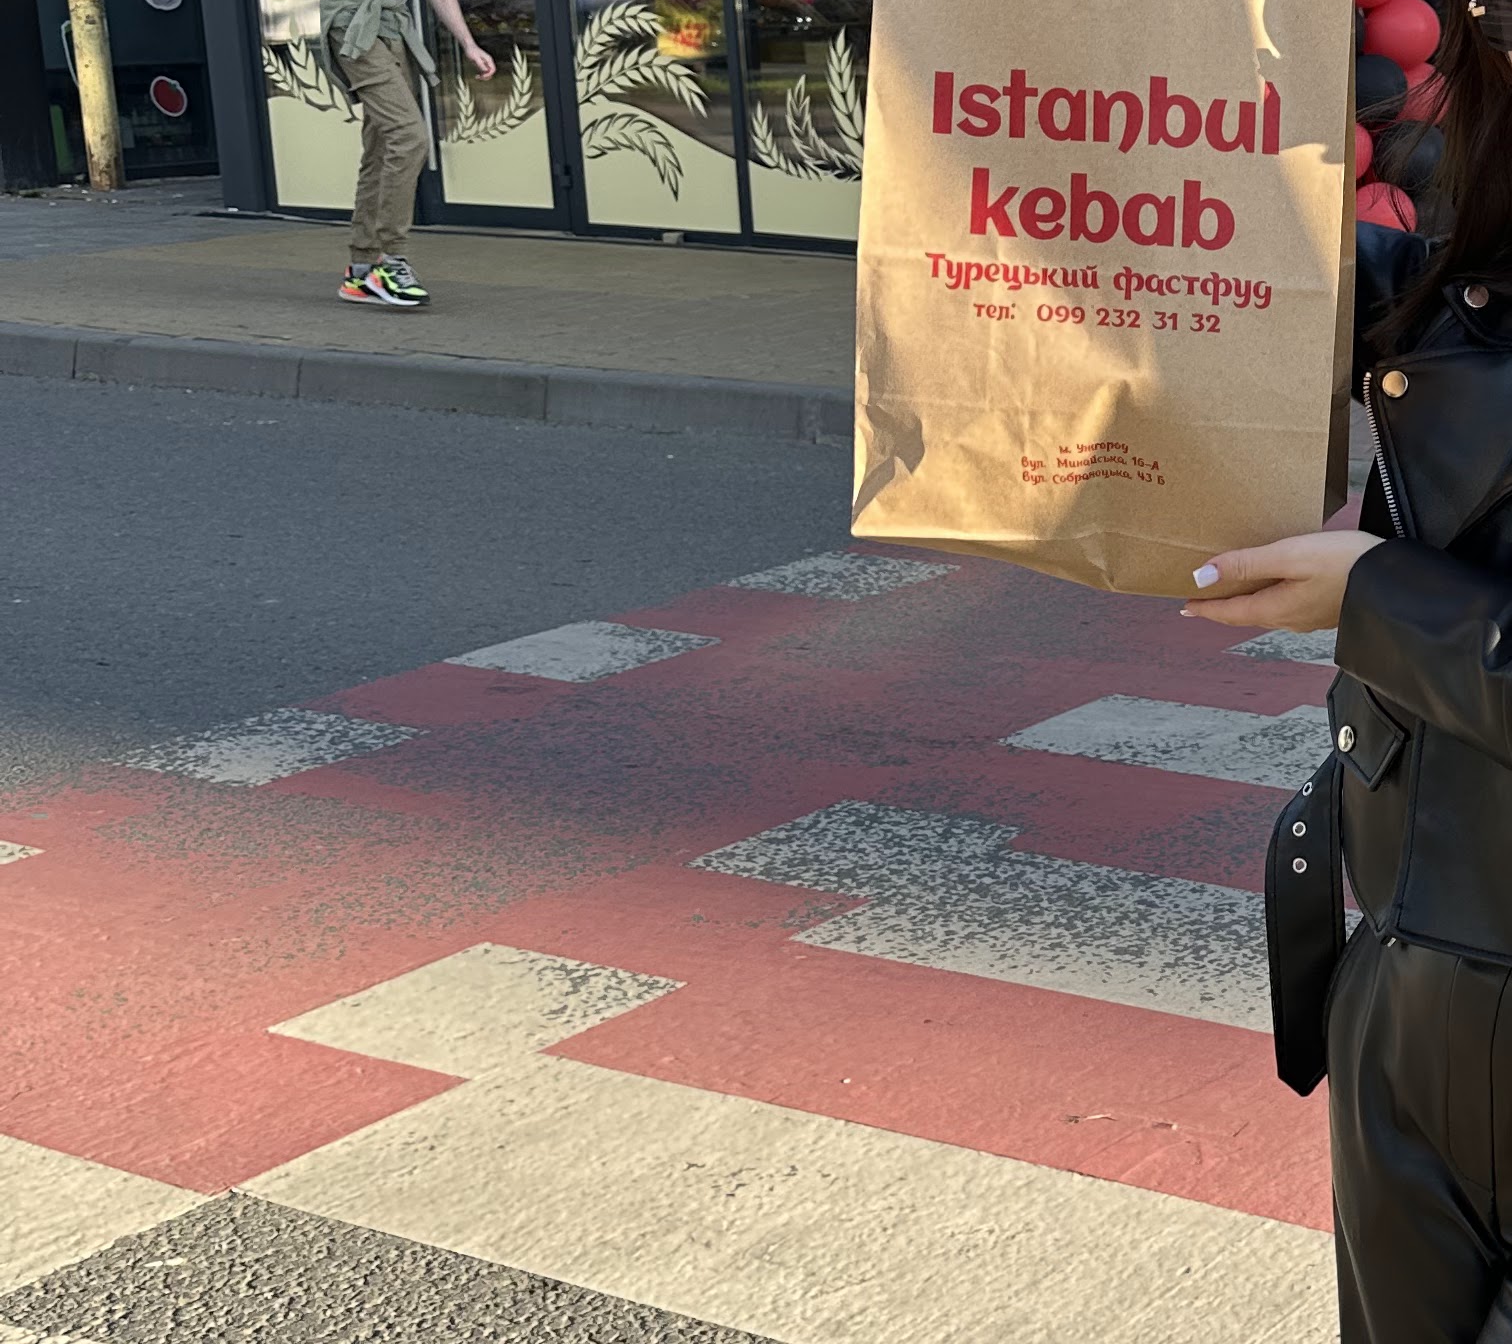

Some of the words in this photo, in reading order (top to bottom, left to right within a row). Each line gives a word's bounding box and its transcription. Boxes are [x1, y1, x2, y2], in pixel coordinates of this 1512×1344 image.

[933, 69, 1281, 156] Istanbul
[970, 167, 1235, 251] kebab
[925, 252, 1100, 291] Турецький
[1113, 265, 1273, 309] фастфуд
[973, 302, 1016, 321] тел:
[1036, 303, 1086, 325] 099
[1096, 307, 1141, 329] 232
[1152, 311, 1178, 331] 31
[1190, 312, 1221, 333] 32
[1137, 470, 1153, 483] 43
